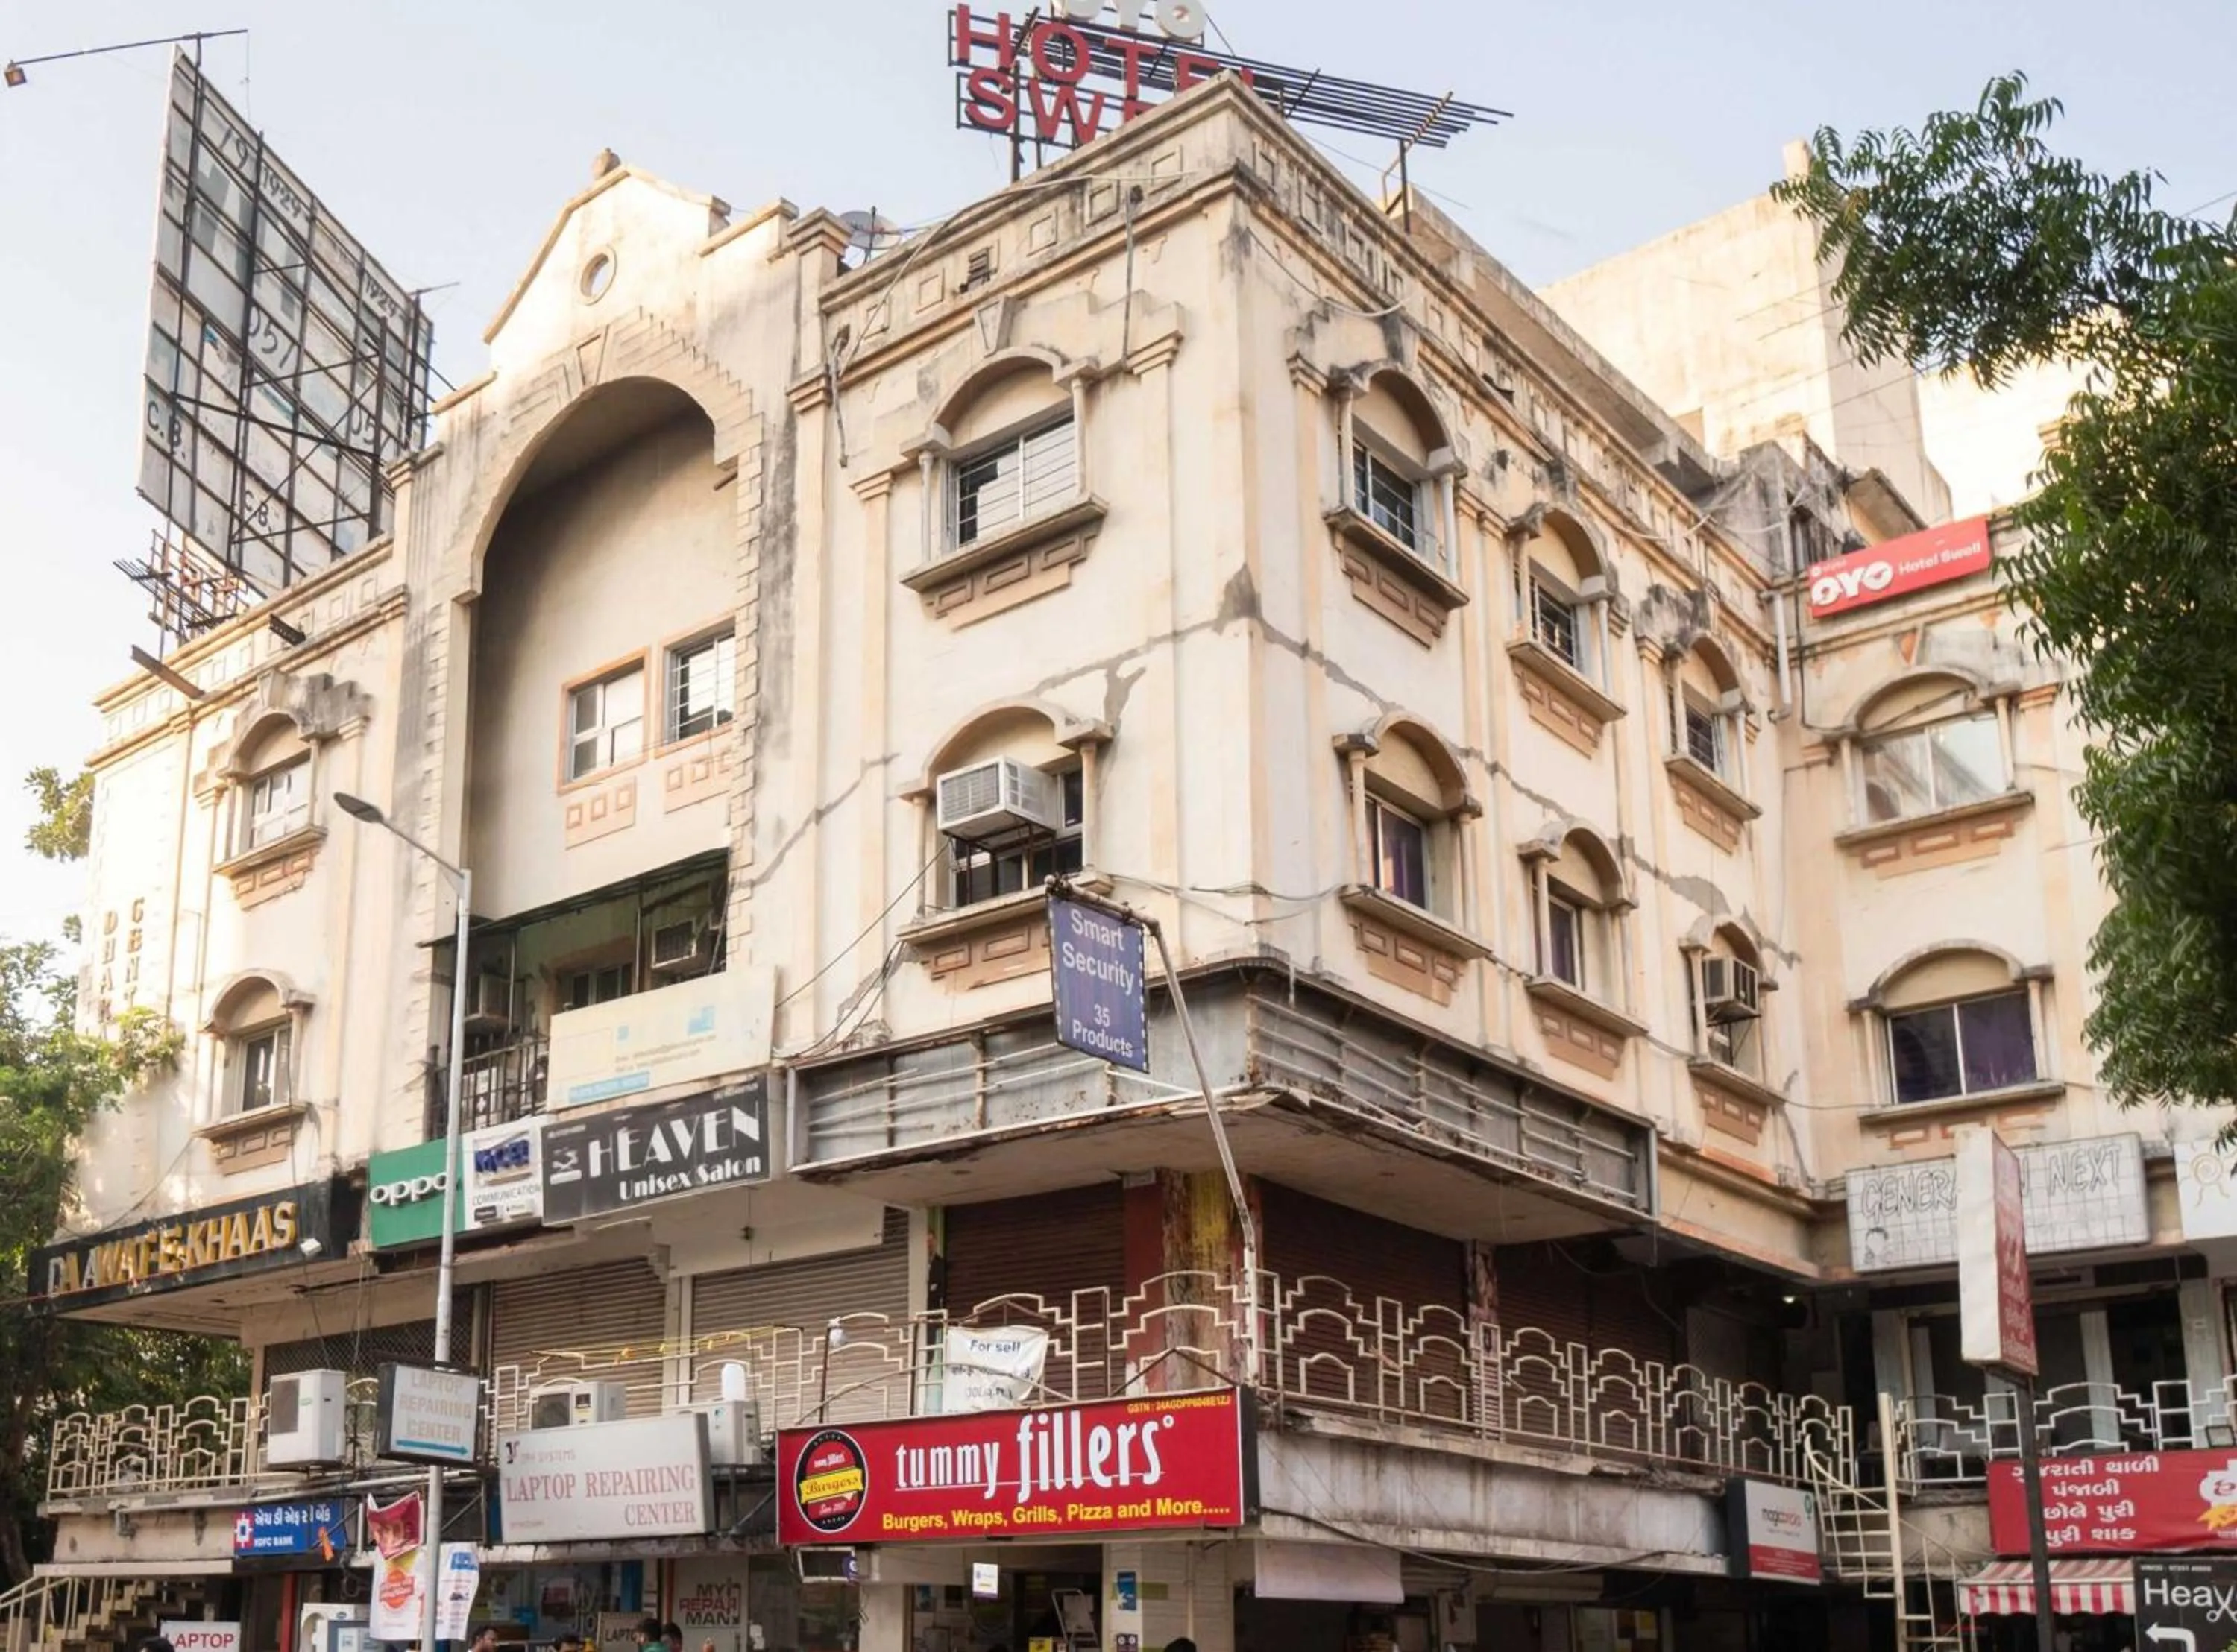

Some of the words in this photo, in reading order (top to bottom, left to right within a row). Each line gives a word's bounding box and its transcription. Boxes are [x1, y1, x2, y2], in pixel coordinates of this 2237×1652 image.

[956, 4, 1253, 98] HOTE
[1812, 561, 1893, 606] OYO
[1898, 557, 1939, 575] Hotel
[1070, 908, 1124, 951] Smart
[1062, 942, 1134, 996] Security
[1093, 1003, 1110, 1027] 35
[1072, 1018, 1133, 1059] Products
[588, 1100, 760, 1178] HEAVEN
[620, 1170, 693, 1201] Unisex
[696, 1156, 761, 1184] Salon
[2048, 1141, 2122, 1197] NEXT
[370, 1173, 450, 1207] oppo
[970, 1340, 991, 1352] For
[995, 1341, 1021, 1353] sell
[411, 1371, 464, 1393] LAPTOP
[399, 1393, 472, 1419] REPAIRING
[504, 1473, 576, 1502] LAPTOP
[585, 1463, 696, 1498] REPAIRING
[895, 1442, 1000, 1500] tummy
[624, 1501, 696, 1526] CENTER
[882, 1513, 948, 1533] Burgers,
[951, 1510, 1008, 1530] Wraps,
[1012, 1505, 1063, 1525] Grills,
[1067, 1503, 1113, 1522] Pizza
[1118, 1498, 1151, 1519] and
[685, 1611, 730, 1625] MAN
[165, 1633, 234, 1648] APTOP
